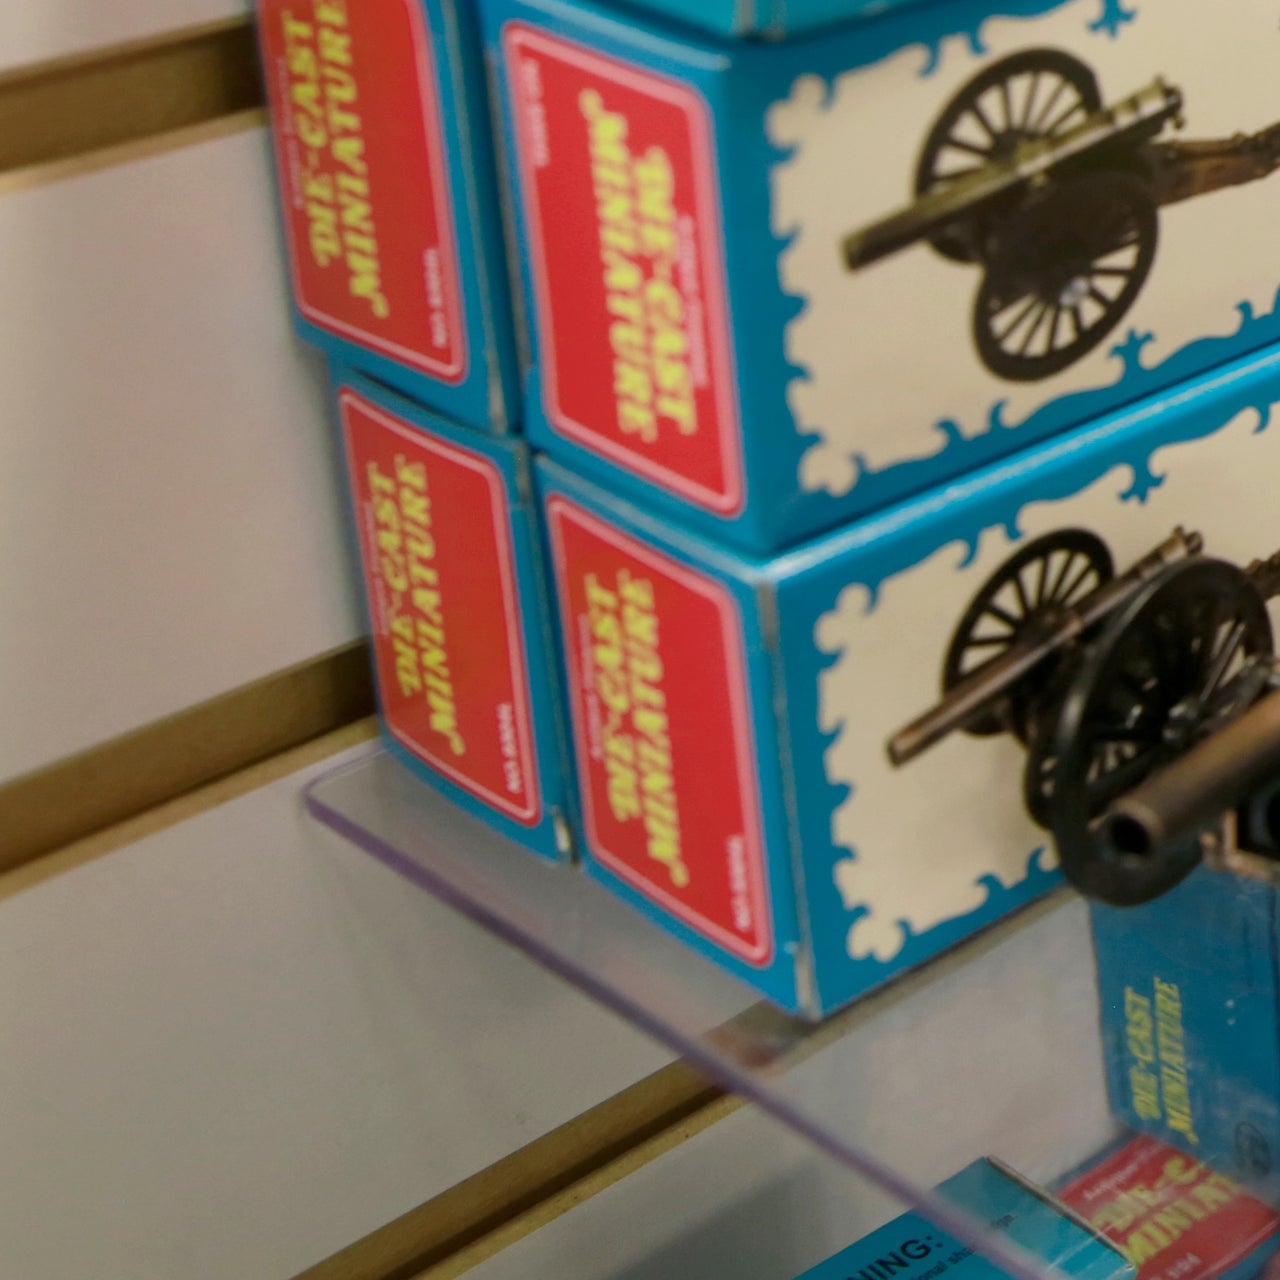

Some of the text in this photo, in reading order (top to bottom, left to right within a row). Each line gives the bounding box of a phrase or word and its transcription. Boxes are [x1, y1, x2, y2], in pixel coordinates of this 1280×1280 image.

[282, 11, 340, 266] DIE-CAST
[580, 89, 657, 443] MINIATURE
[367, 462, 422, 697] DIE-CAST
[395, 455, 465, 756] MINIATURE
[617, 568, 689, 888] MINIATURE
[1124, 986, 1163, 1121] DIE-CAST
[1153, 976, 1199, 1144] MINIATURE
[844, 1235, 944, 1280] NING:
